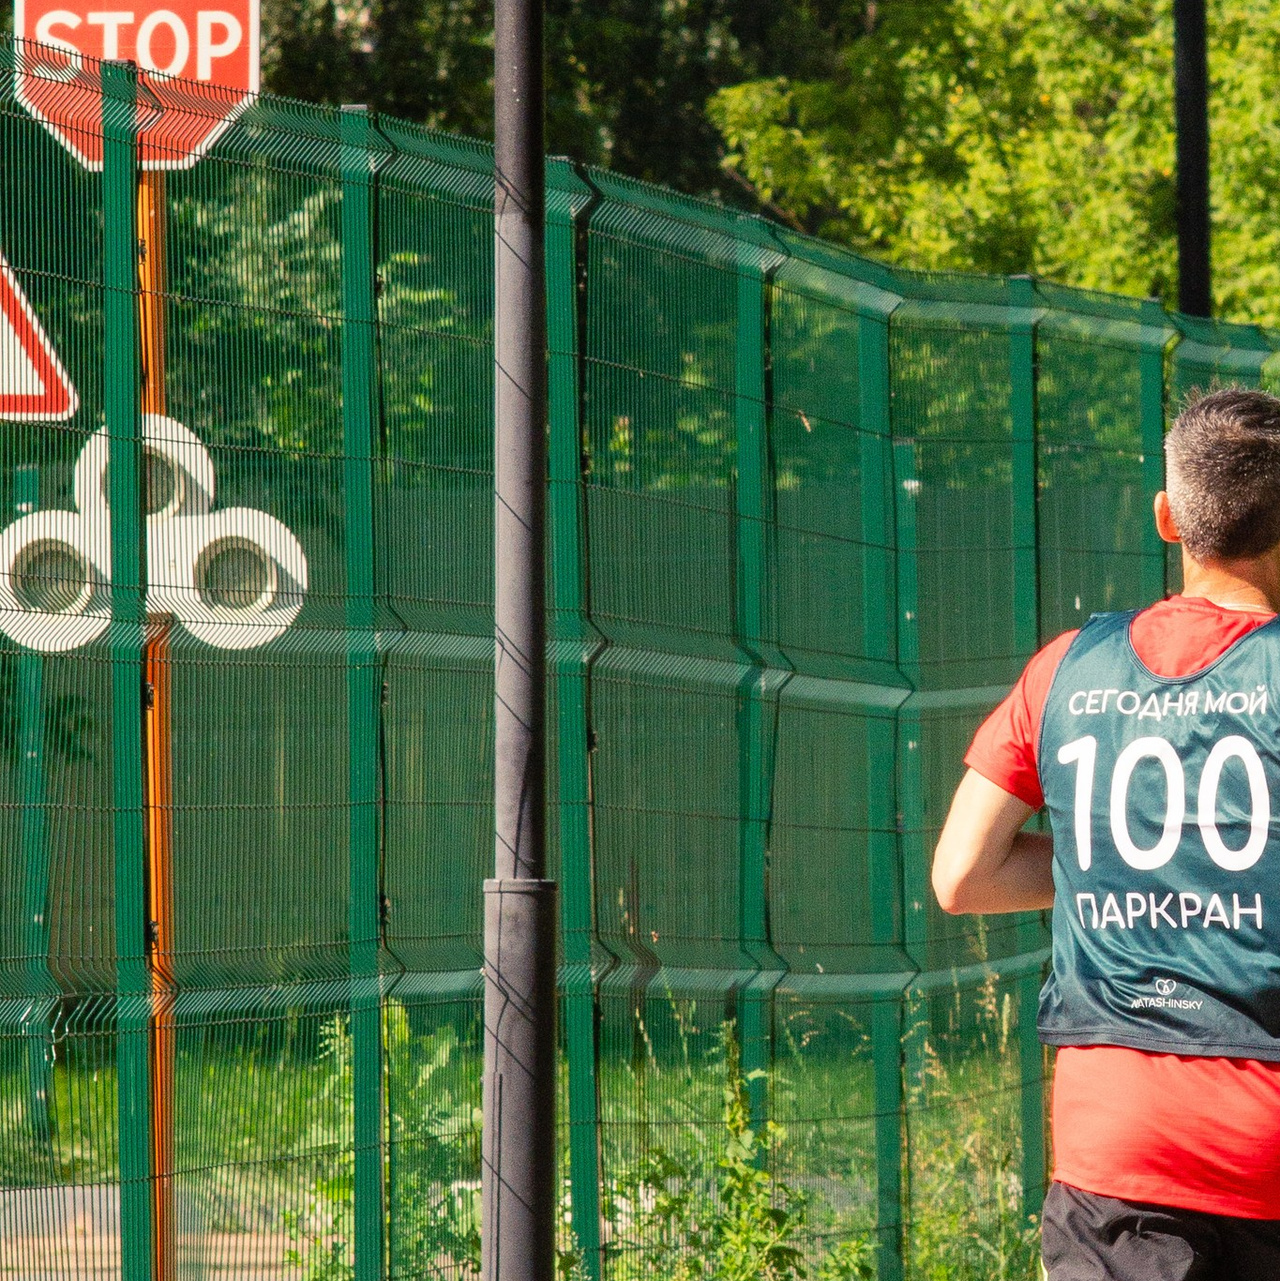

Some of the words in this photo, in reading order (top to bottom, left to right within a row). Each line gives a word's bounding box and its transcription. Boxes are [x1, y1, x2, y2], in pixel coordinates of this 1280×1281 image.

[33, 9, 243, 82] STOP
[1069, 689, 1199, 722] СЕГОДНЯ
[1204, 685, 1268, 715] МОЙ
[1057, 735, 1270, 872] 100
[1076, 892, 1263, 930] ПАРКРАН
[1130, 997, 1203, 1010] NATASHINSKY
